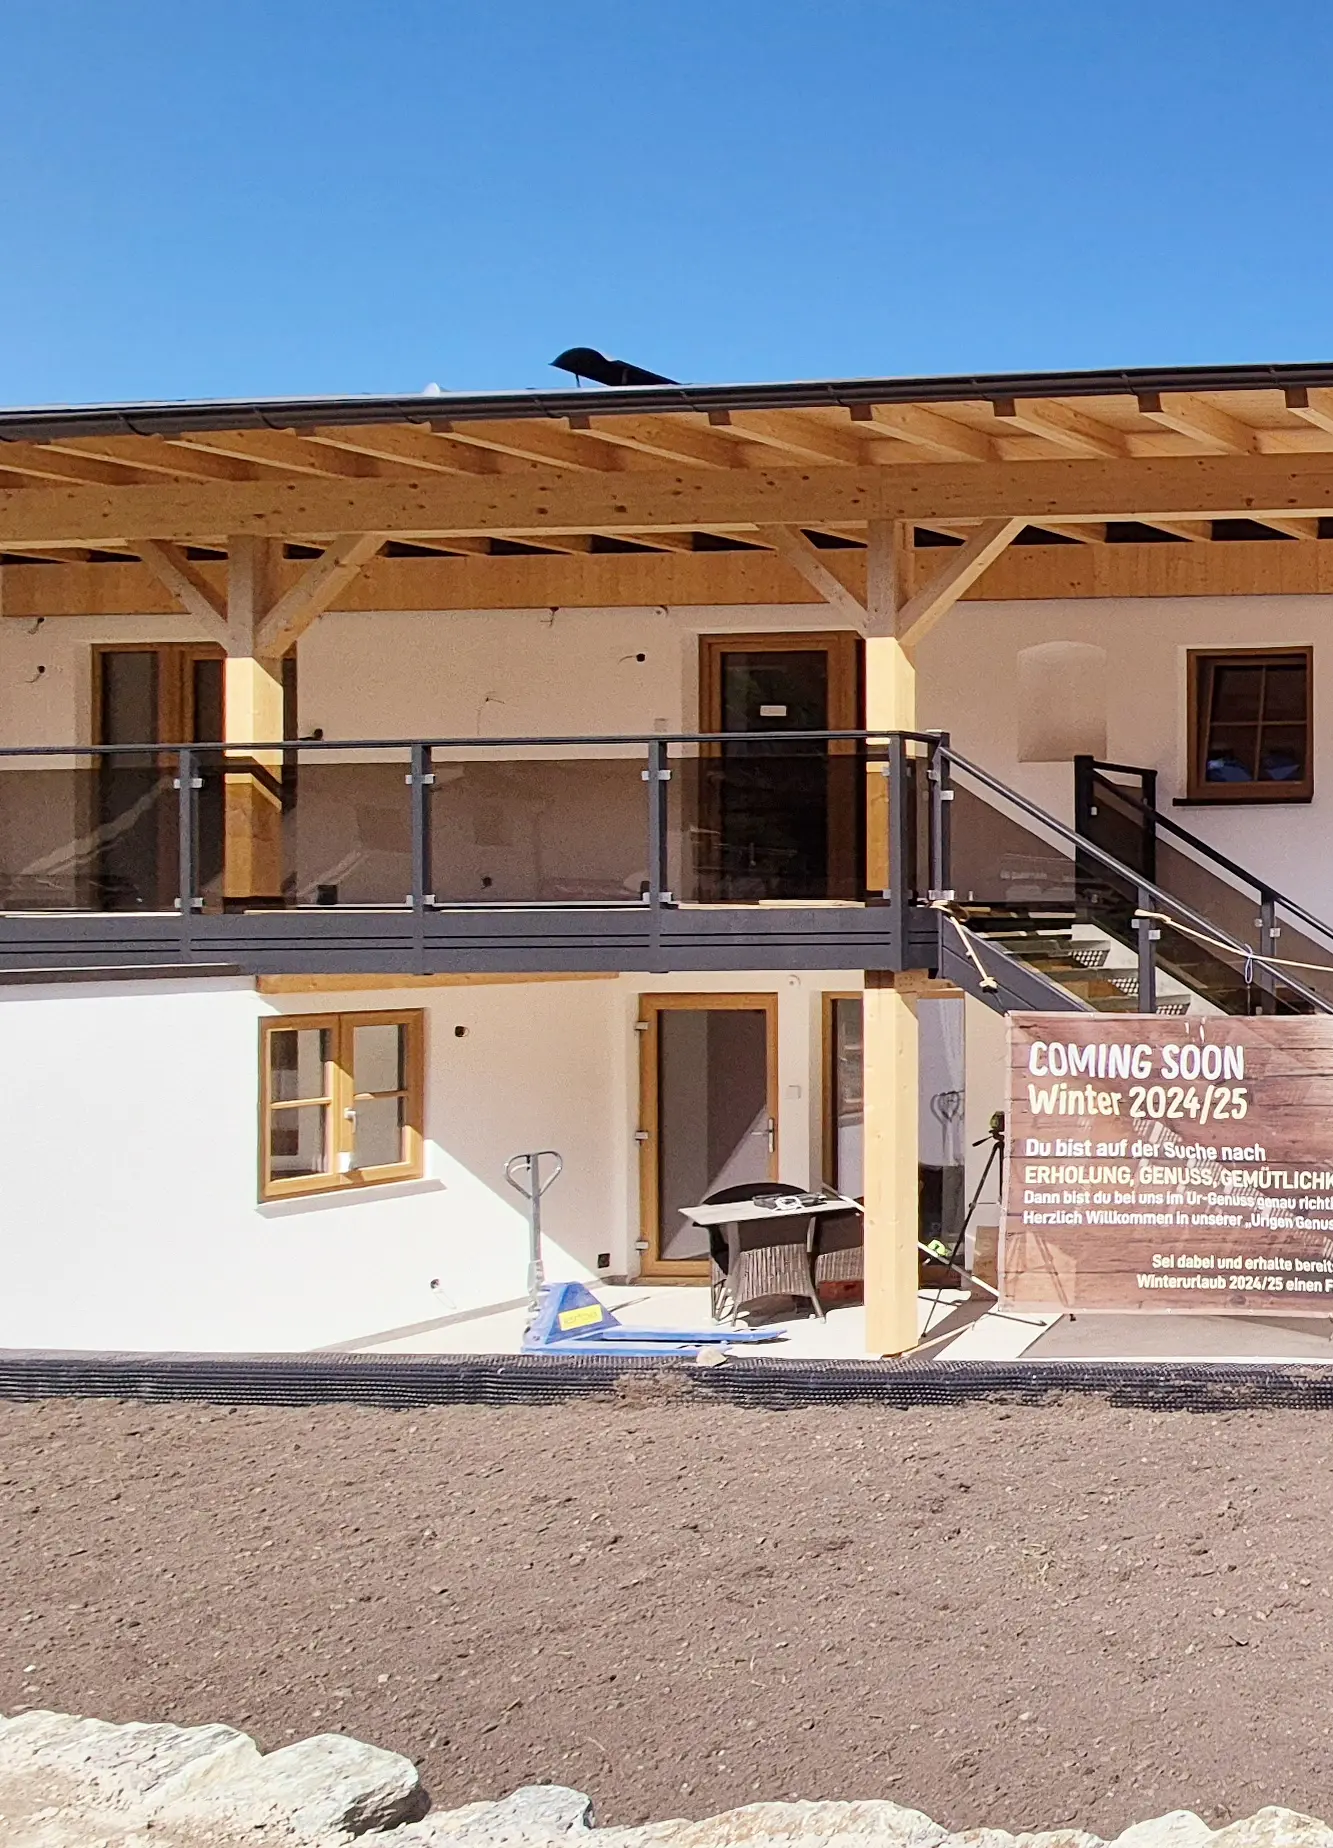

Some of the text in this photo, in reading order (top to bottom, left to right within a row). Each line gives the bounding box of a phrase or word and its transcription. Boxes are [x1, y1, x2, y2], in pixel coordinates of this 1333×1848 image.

[1029, 1041, 1245, 1080] COMING SOON
[1027, 1083, 1248, 1125] Winter 2024/25
[1025, 1138, 1266, 1161] Du bist auf der Suche nach
[1025, 1165, 1134, 1187] ERHOLUNG,
[1139, 1167, 1218, 1187] GENUSS,
[1024, 1190, 1060, 1204] Dann
[1063, 1191, 1090, 1204] bist
[1093, 1191, 1112, 1204] du
[1114, 1191, 1136, 1204] bei
[1138, 1194, 1164, 1205] uns
[1166, 1192, 1183, 1205] im
[1186, 1192, 1254, 1206] Ur-Genuss
[1256, 1198, 1296, 1211] genau
[1023, 1210, 1082, 1225] Herzlich
[1085, 1210, 1173, 1225] Willkommen
[1176, 1211, 1188, 1225] in
[1192, 1215, 1243, 1226] unserer
[1152, 1254, 1174, 1268] Sei
[1177, 1254, 1214, 1269] dabei
[1217, 1255, 1242, 1269] und
[1244, 1256, 1292, 1272] erhalte
[1136, 1274, 1226, 1289] Winterurlaub
[1229, 1275, 1283, 1291] 2024/25
[1286, 1277, 1323, 1292] einen
